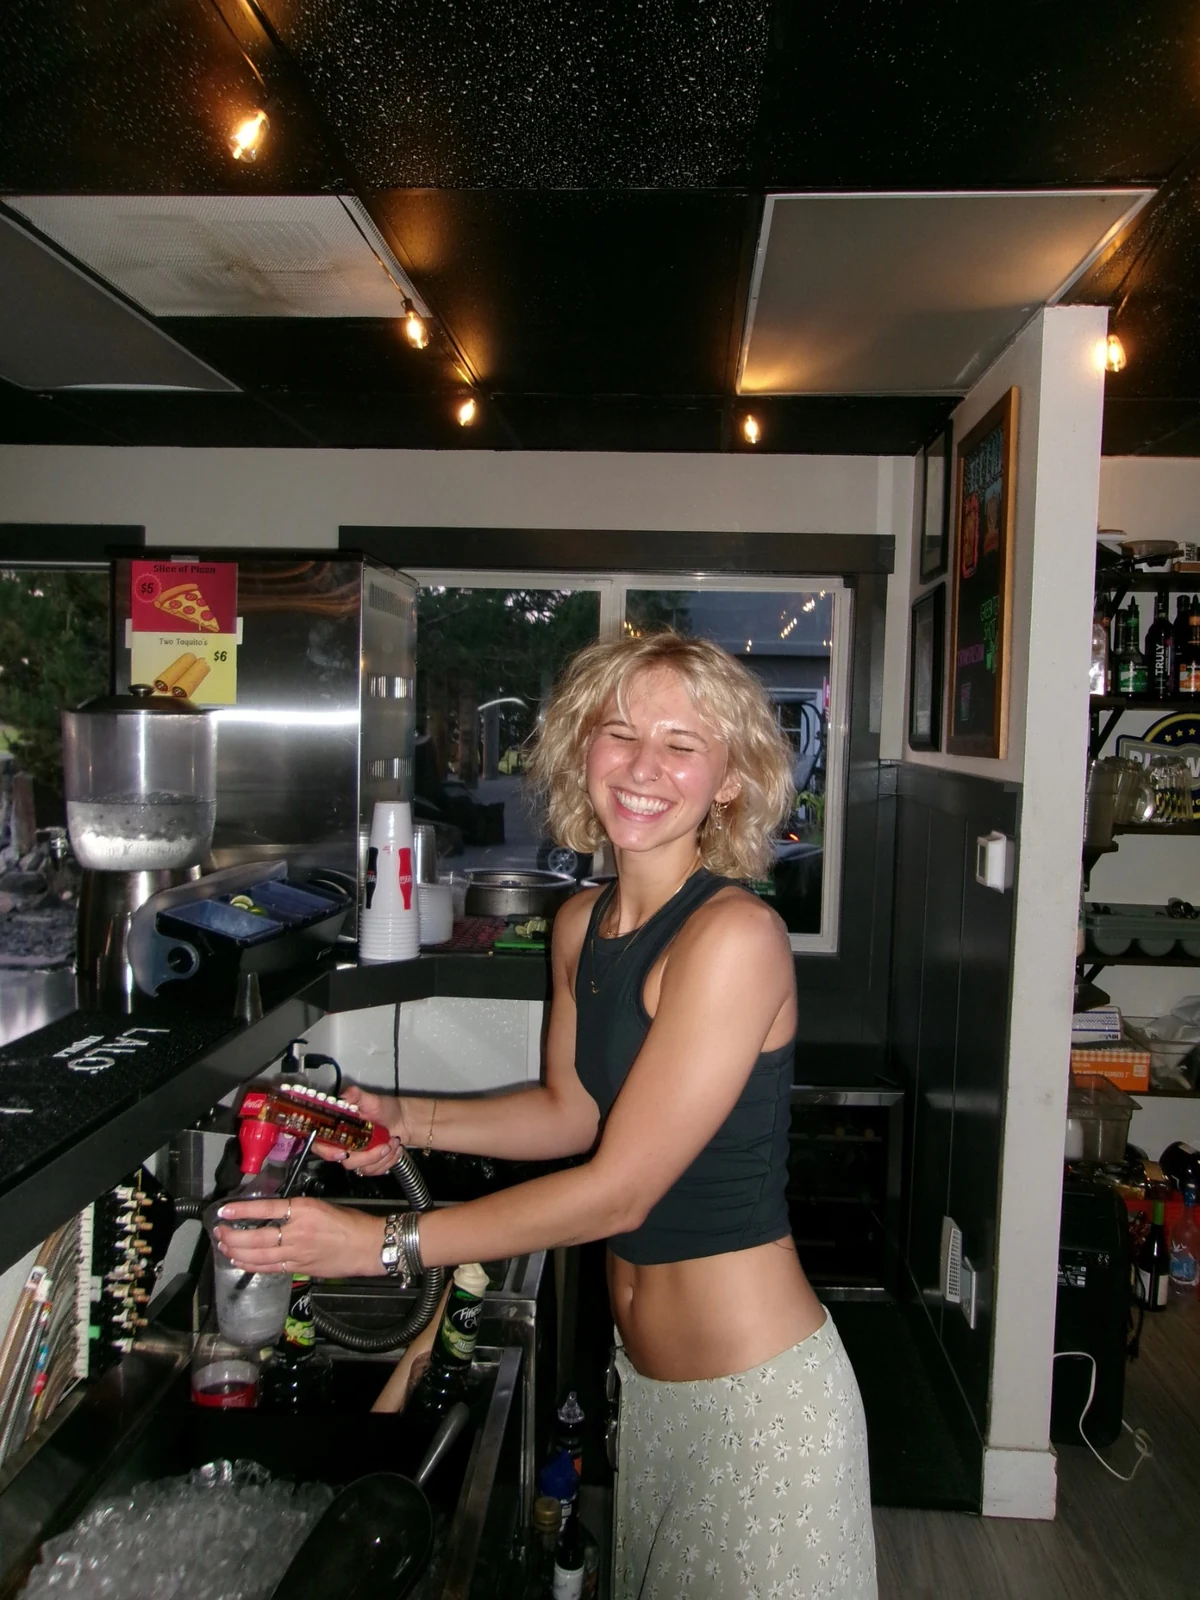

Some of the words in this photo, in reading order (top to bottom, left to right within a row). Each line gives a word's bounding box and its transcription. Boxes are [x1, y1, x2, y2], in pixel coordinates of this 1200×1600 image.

[153, 564, 177, 574] Slice
[178, 564, 189, 574] of
[140, 582, 154, 594] $5
[159, 637, 174, 646] Two
[175, 637, 208, 647] Taquito's
[213, 650, 228, 663] $6
[1155, 643, 1165, 676] TRULY
